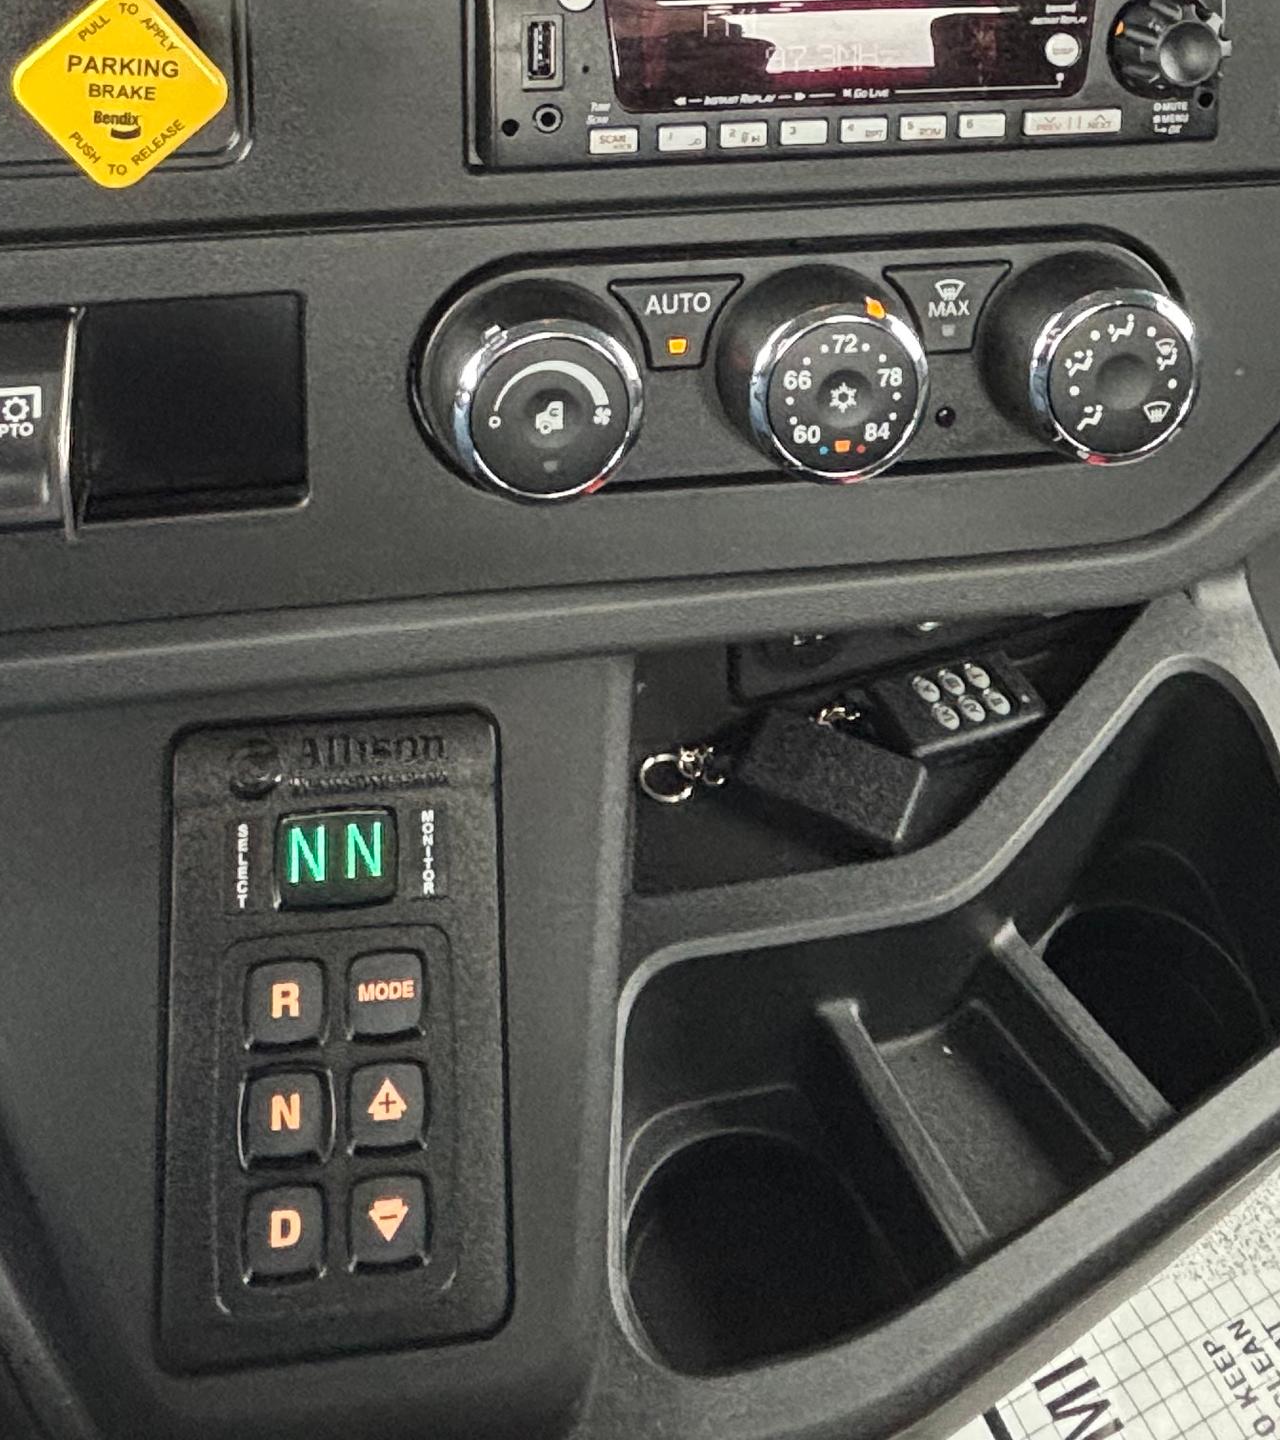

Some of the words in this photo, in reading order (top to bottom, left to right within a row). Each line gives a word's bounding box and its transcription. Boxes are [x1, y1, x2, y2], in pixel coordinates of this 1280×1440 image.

[77, 14, 111, 42] PULL
[118, 2, 139, 16] TO
[140, 16, 180, 53] APPLY
[66, 54, 180, 79] PARKING
[88, 83, 157, 101] BRAKE
[93, 110, 142, 126] Bendix
[68, 131, 101, 164] PUSH
[107, 163, 128, 176] TO
[131, 118, 186, 167] RELEASE
[598, 134, 627, 145] SCAN
[645, 291, 712, 316] AUTO
[928, 300, 970, 319] MAX
[831, 333, 859, 354] 72
[783, 370, 812, 391] 66
[877, 367, 904, 388] 78
[793, 424, 821, 444] 60
[863, 422, 891, 443] 84
[288, 824, 326, 885] N
[345, 820, 385, 880] N
[422, 809, 435, 896] MONITOR
[237, 823, 250, 910] SELECT
[271, 982, 300, 1019] R
[358, 979, 416, 1002] MODE
[271, 1093, 301, 1132] N
[270, 1209, 302, 1249] D
[1202, 1339, 1260, 1410] KEEP
